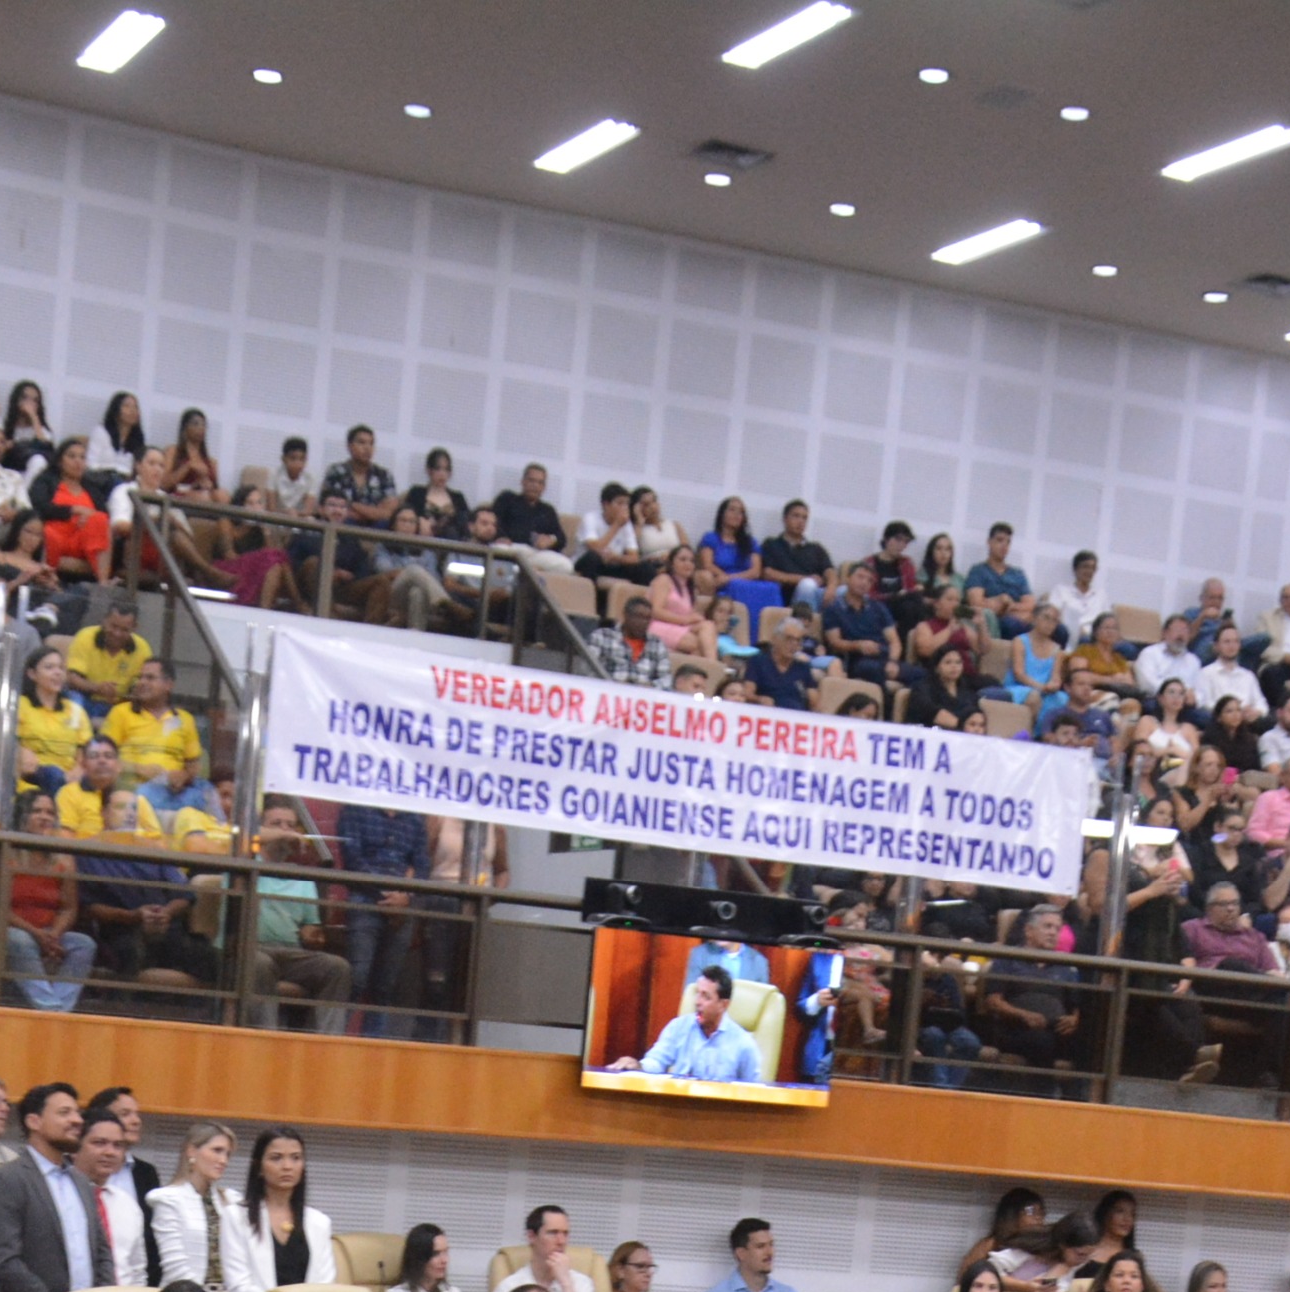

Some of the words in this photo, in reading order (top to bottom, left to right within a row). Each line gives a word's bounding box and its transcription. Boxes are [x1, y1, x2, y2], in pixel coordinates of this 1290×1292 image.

[329, 699, 435, 748] HONRA
[446, 717, 484, 756] DE
[492, 724, 618, 778] PRESTAR
[627, 747, 716, 792] JUSTA
[725, 760, 911, 816] HOMENAGEM
[919, 786, 936, 819] A
[945, 788, 1035, 832] TODOS
[431, 664, 585, 724] VEREADOR
[593, 692, 728, 745] ANSELMO
[737, 715, 858, 763] PEREIRA
[868, 732, 926, 771] TEM
[933, 741, 952, 775] A
[294, 743, 551, 815] TRABALHADORES
[561, 784, 734, 840] GOIANIENSE
[742, 810, 812, 850] AQUI
[821, 818, 1056, 880] REPRESENTANDO
